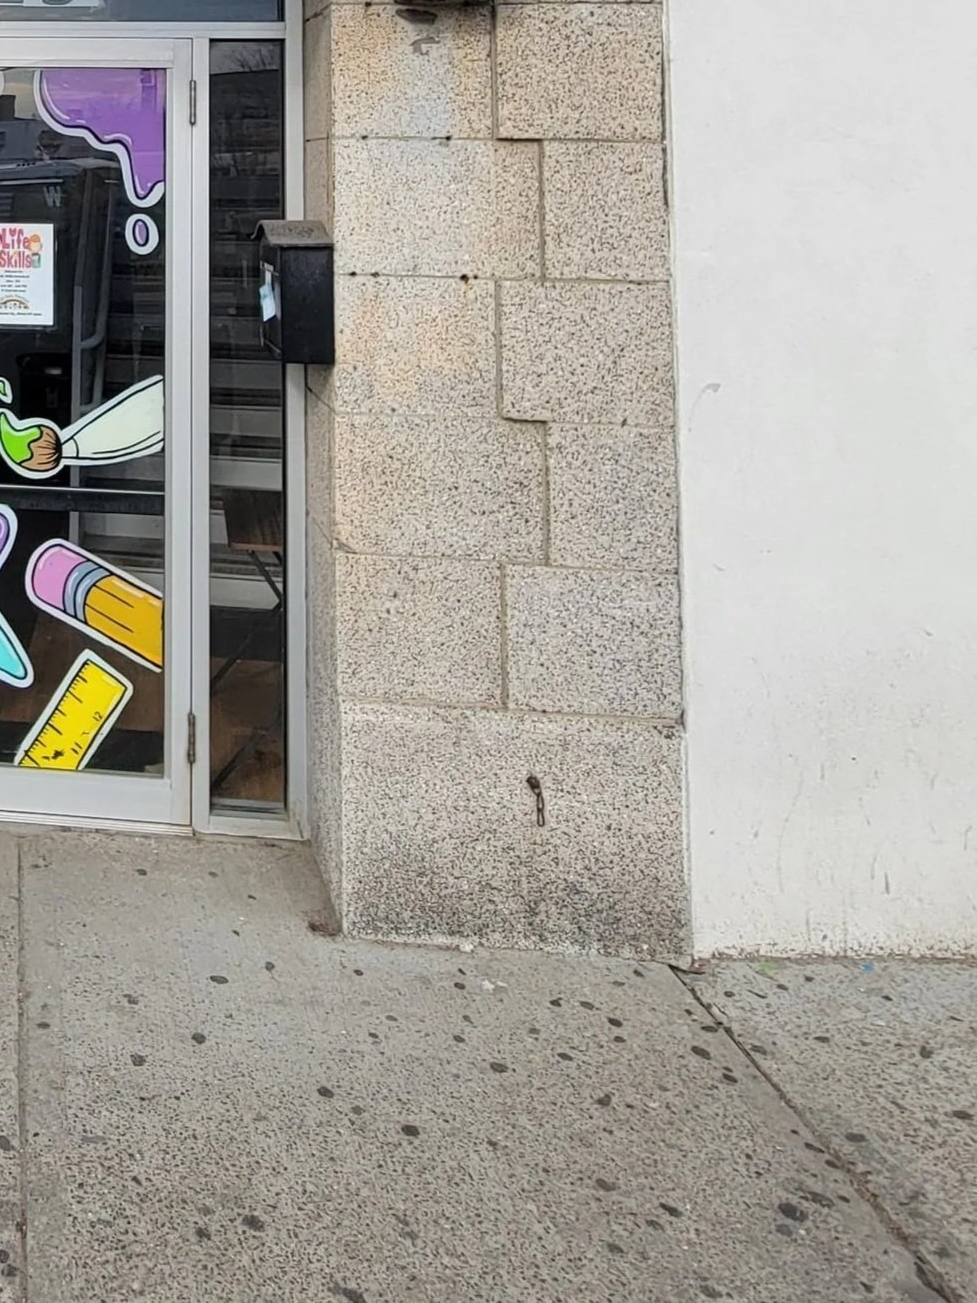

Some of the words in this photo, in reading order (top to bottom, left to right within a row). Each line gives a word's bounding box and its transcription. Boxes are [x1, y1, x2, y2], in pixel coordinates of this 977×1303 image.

[2, 227, 30, 250] Life
[0, 250, 32, 269] Skills
[92, 711, 103, 722] 12
